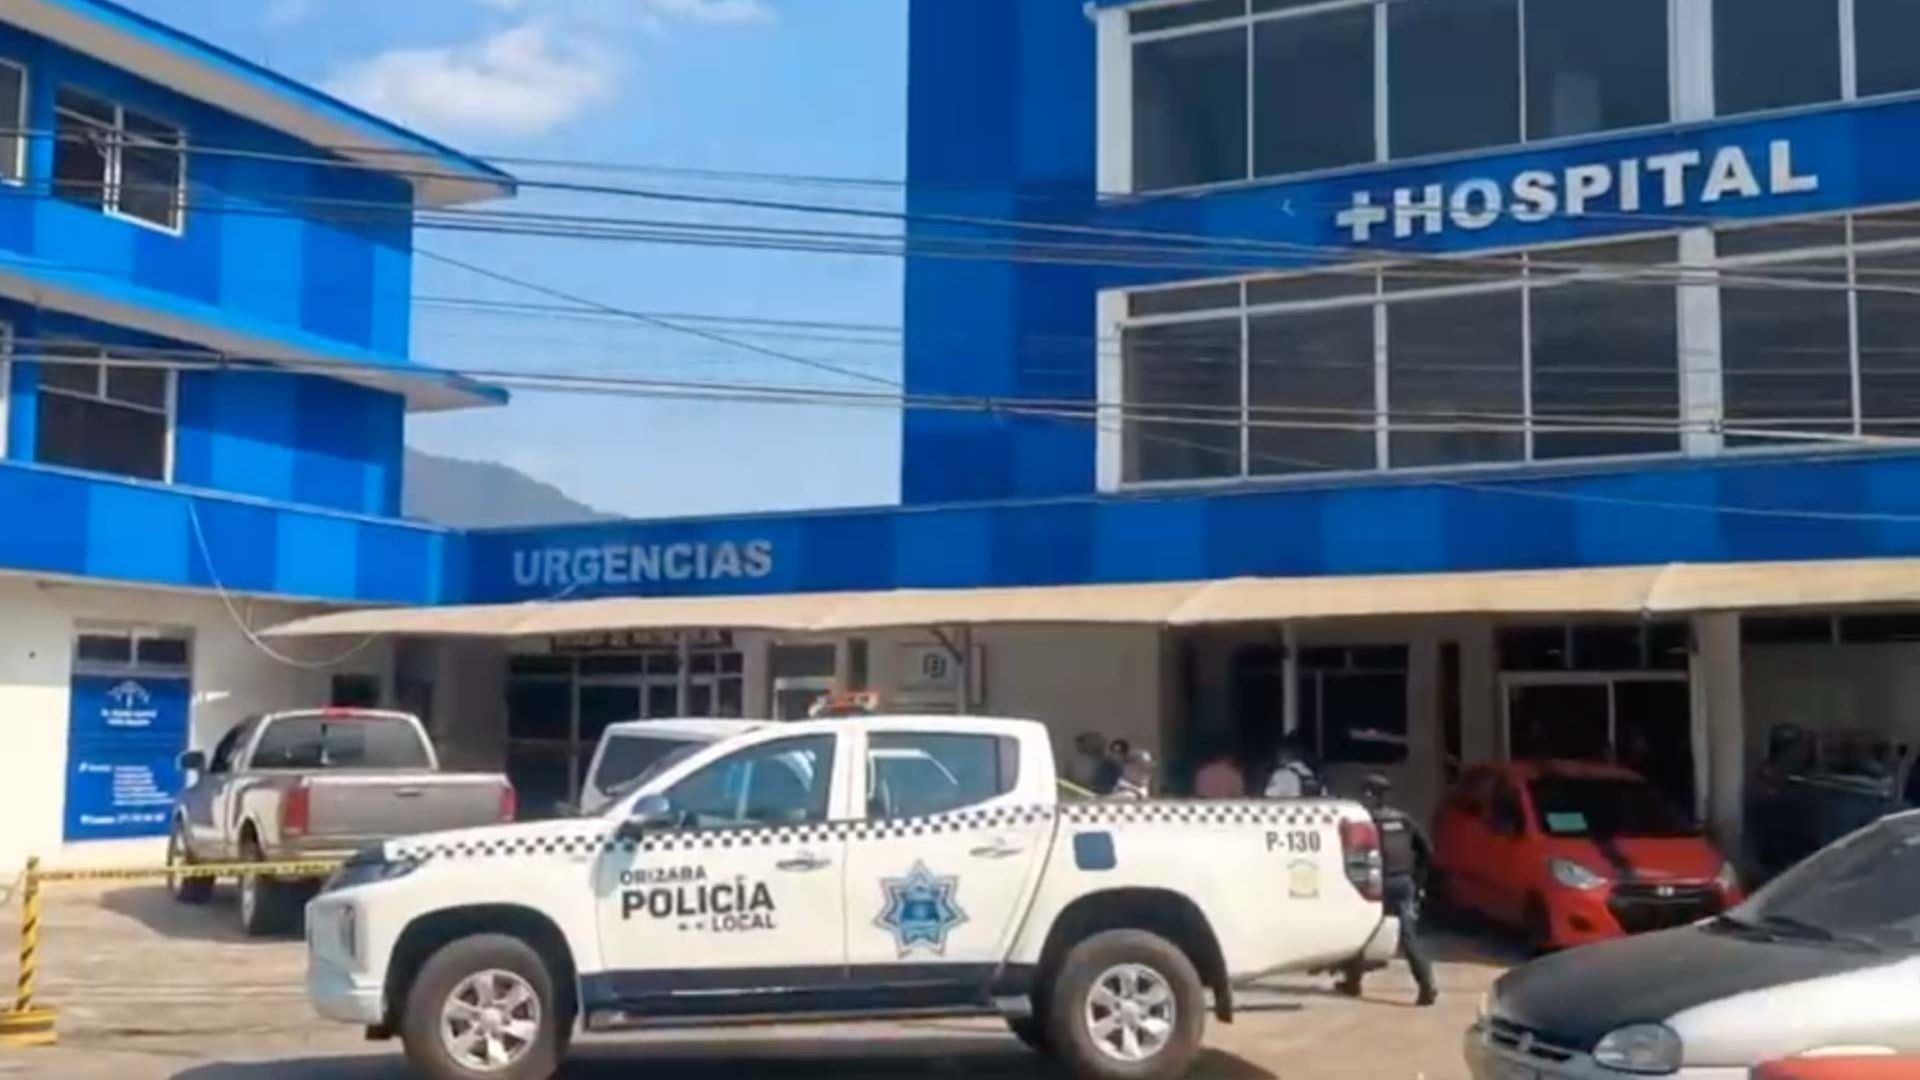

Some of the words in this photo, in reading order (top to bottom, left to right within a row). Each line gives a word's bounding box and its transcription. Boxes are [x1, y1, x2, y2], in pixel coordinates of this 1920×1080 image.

[1394, 140, 1818, 237] HOSPITAL
[513, 539, 773, 586] URGENCIAS
[1266, 831, 1321, 852] P-130
[620, 865, 707, 885] ORIZABA
[622, 874, 775, 919] POLICÍA
[712, 913, 776, 932] LOCAL
